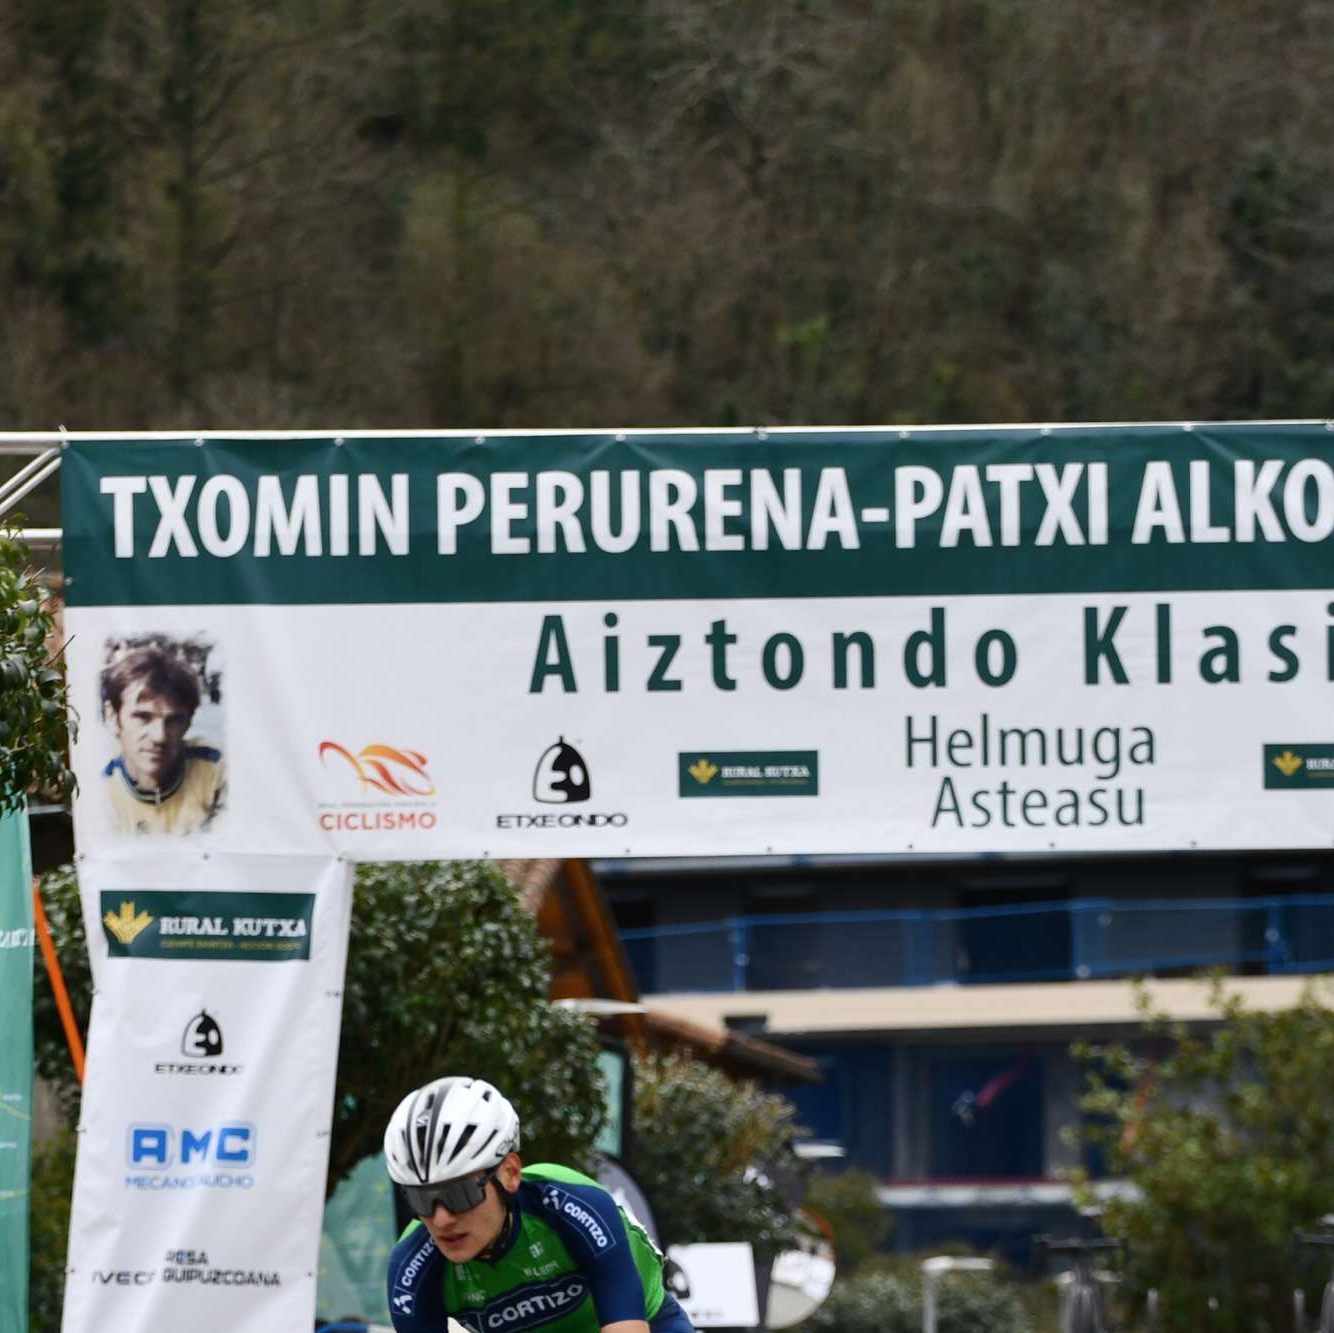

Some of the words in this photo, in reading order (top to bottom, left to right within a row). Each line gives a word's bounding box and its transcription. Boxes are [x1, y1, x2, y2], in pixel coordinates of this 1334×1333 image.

[100, 472, 410, 558] TXOMIN
[437, 463, 1108, 555] PERURENA-PATXI
[529, 605, 1018, 694] Aiztondo
[905, 713, 1155, 780] Helmuga
[318, 811, 436, 832] CICLISMO
[496, 812, 629, 828] ETXEONDO
[931, 774, 1144, 828] Asteasu
[159, 917, 229, 936] RURAL
[233, 918, 307, 937] KUTXA
[132, 1127, 251, 1164] AMC
[564, 1201, 609, 1248] CORTIZO
[487, 1283, 584, 1329] CORTIZO
